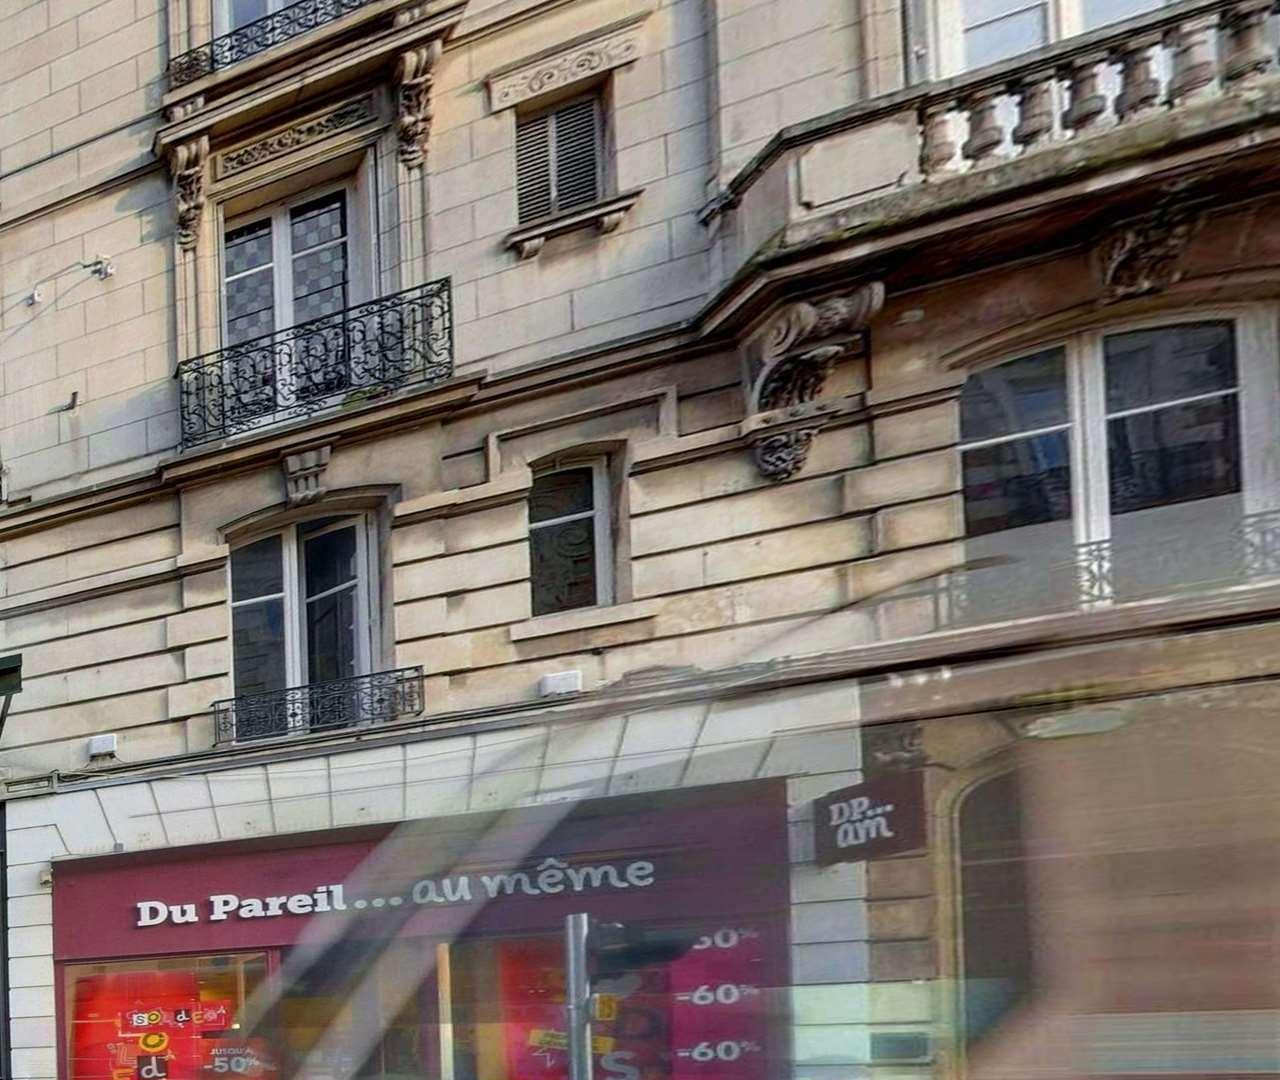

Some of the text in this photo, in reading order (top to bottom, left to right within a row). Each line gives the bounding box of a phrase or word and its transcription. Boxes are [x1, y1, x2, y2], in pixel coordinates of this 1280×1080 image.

[837, 816, 894, 848] am
[136, 900, 199, 927] Du
[412, 874, 472, 905] au
[481, 858, 655, 899] même
